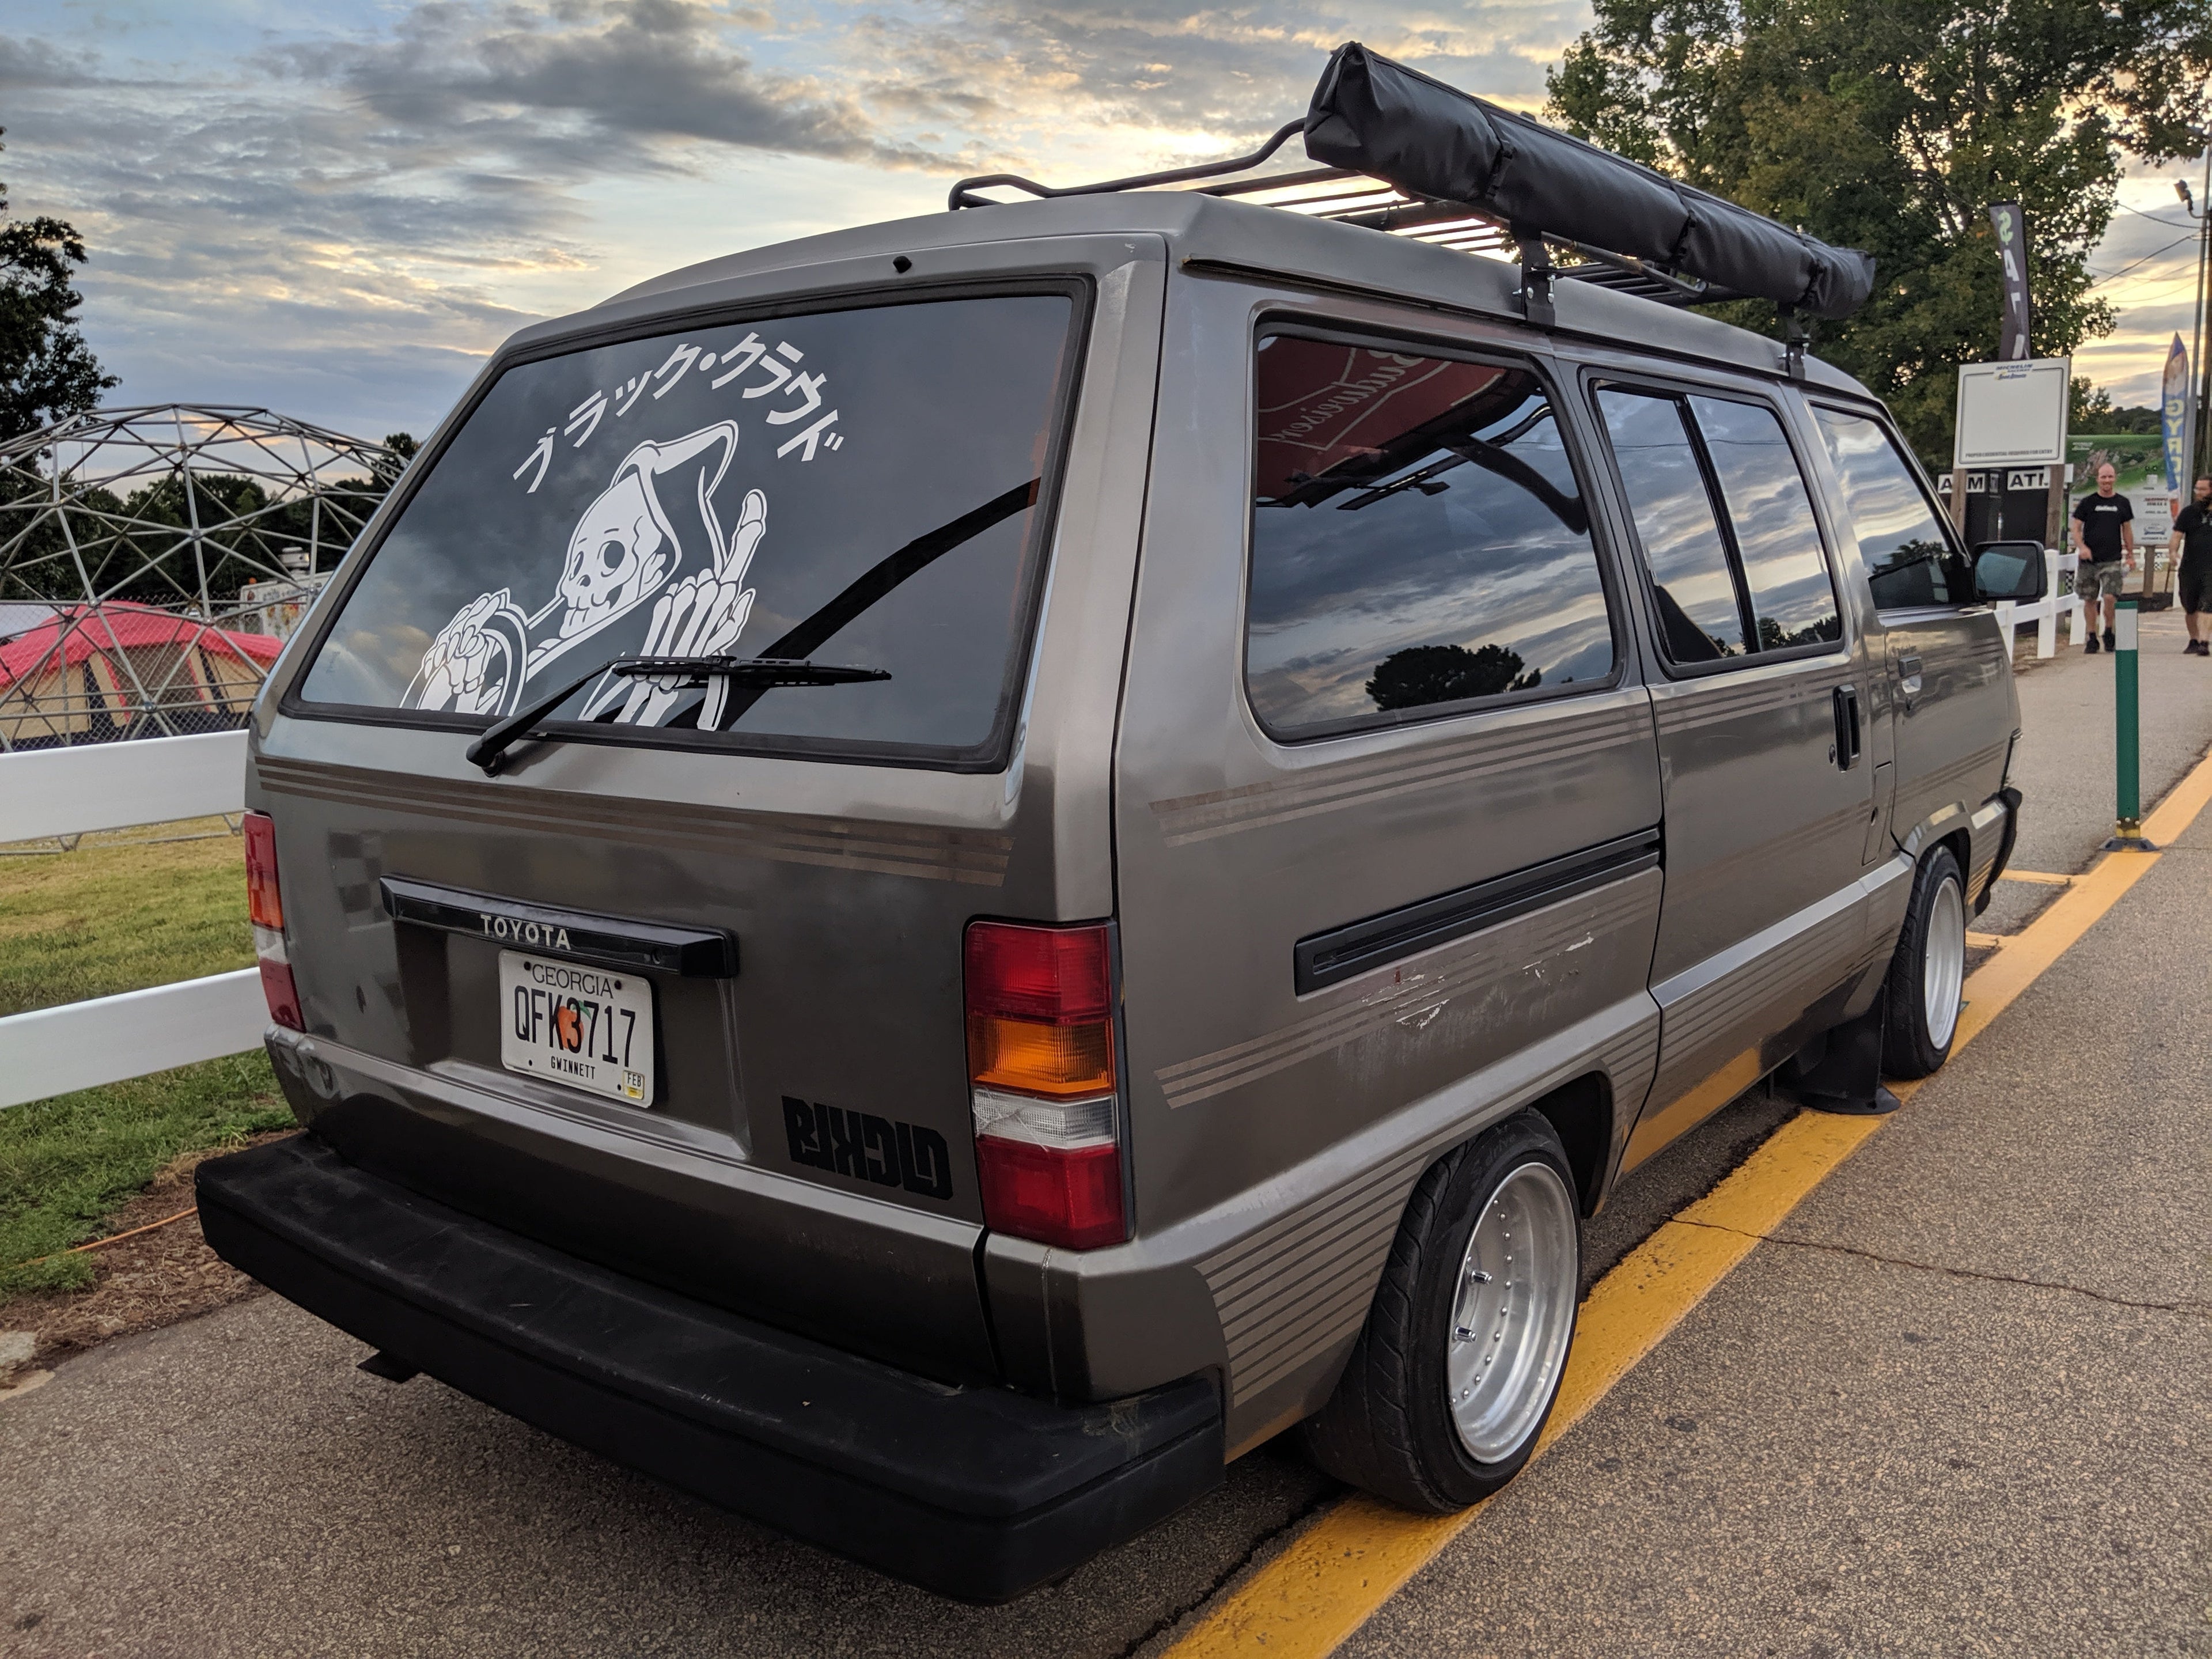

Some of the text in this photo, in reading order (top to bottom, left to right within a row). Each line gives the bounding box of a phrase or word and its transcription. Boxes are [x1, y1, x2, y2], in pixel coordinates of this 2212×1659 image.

[480, 914, 571, 950] TOYOTA
[532, 964, 614, 999] GEORGIA
[514, 985, 636, 1067] QFK3717
[550, 1056, 596, 1080] GWINNETT
[627, 1073, 641, 1087] FEB
